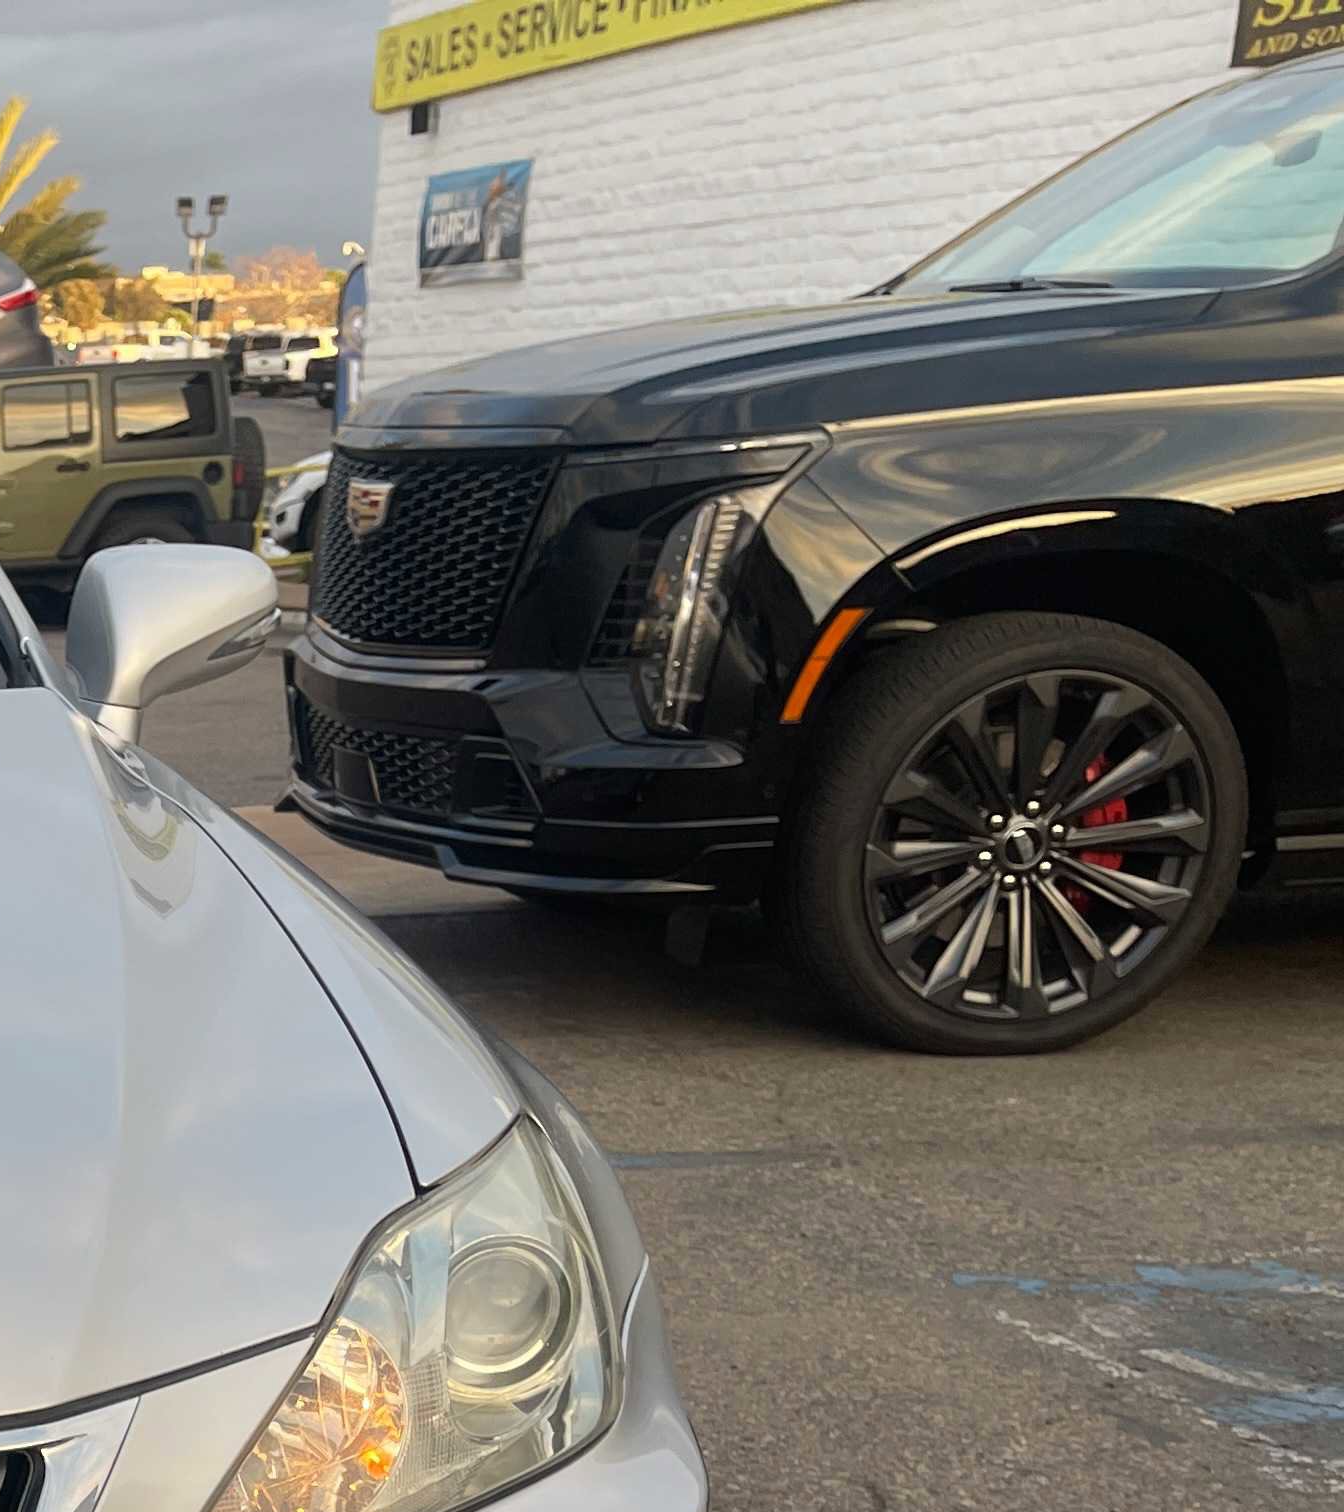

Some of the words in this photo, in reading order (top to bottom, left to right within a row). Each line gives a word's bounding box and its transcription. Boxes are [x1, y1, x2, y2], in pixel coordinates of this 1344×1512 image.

[405, 22, 478, 82] SALES
[496, 0, 608, 59] SERVICE
[1245, 32, 1298, 59] AND
